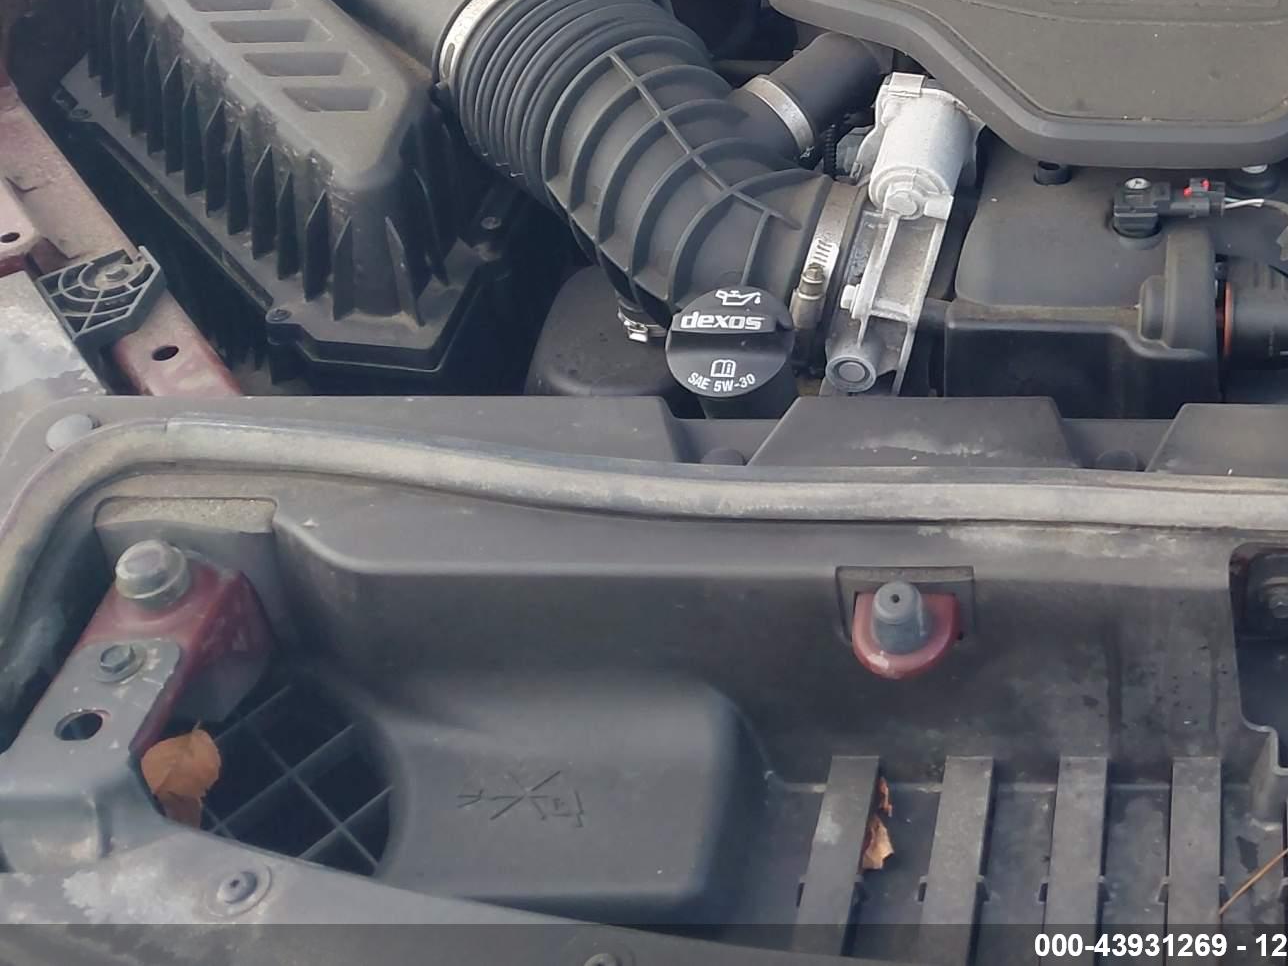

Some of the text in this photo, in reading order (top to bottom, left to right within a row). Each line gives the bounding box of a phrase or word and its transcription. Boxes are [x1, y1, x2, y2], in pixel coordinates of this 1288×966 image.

[680, 311, 765, 330] dexos
[687, 372, 756, 392] SAE 5W-30
